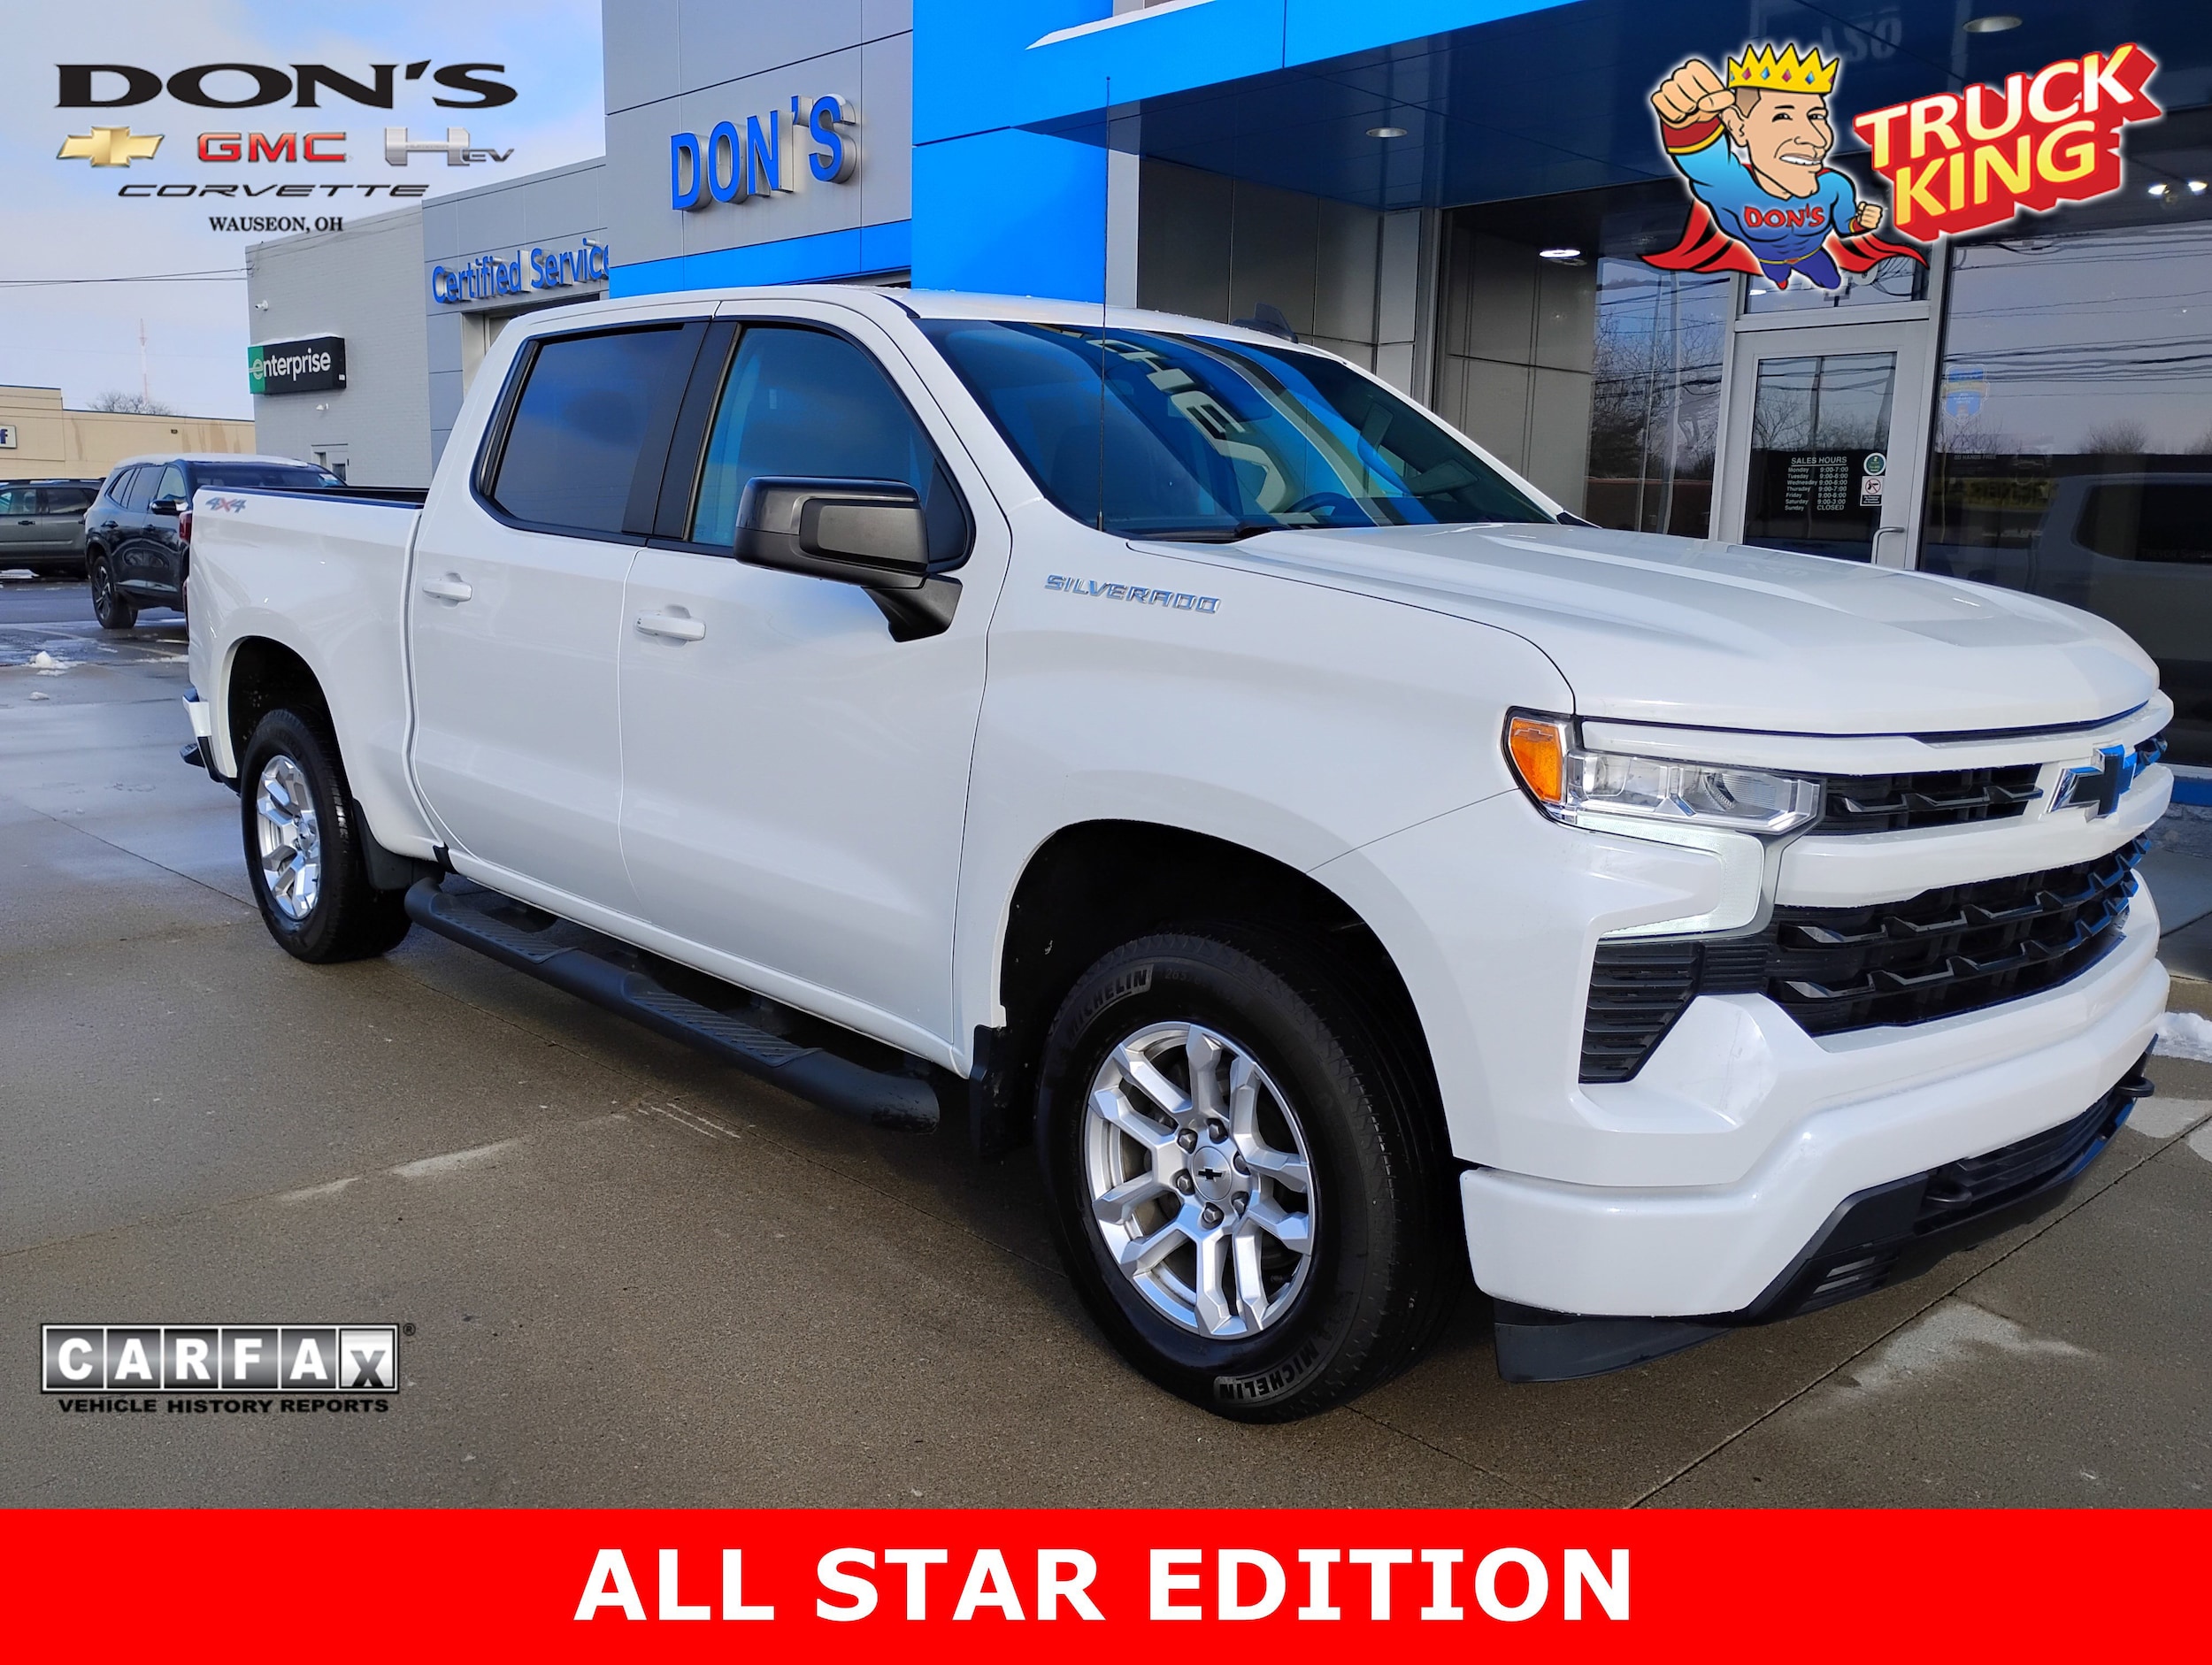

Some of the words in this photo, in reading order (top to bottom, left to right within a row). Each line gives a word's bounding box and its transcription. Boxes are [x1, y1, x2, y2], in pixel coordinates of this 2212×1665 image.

[671, 94, 853, 211] DON'S
[432, 249, 523, 304] Certified
[251, 348, 332, 382] enterprise
[1043, 574, 1222, 614] SILVERADO
[1069, 969, 1148, 1041] MICHELIN
[1219, 1339, 1320, 1400] MICHELIN
